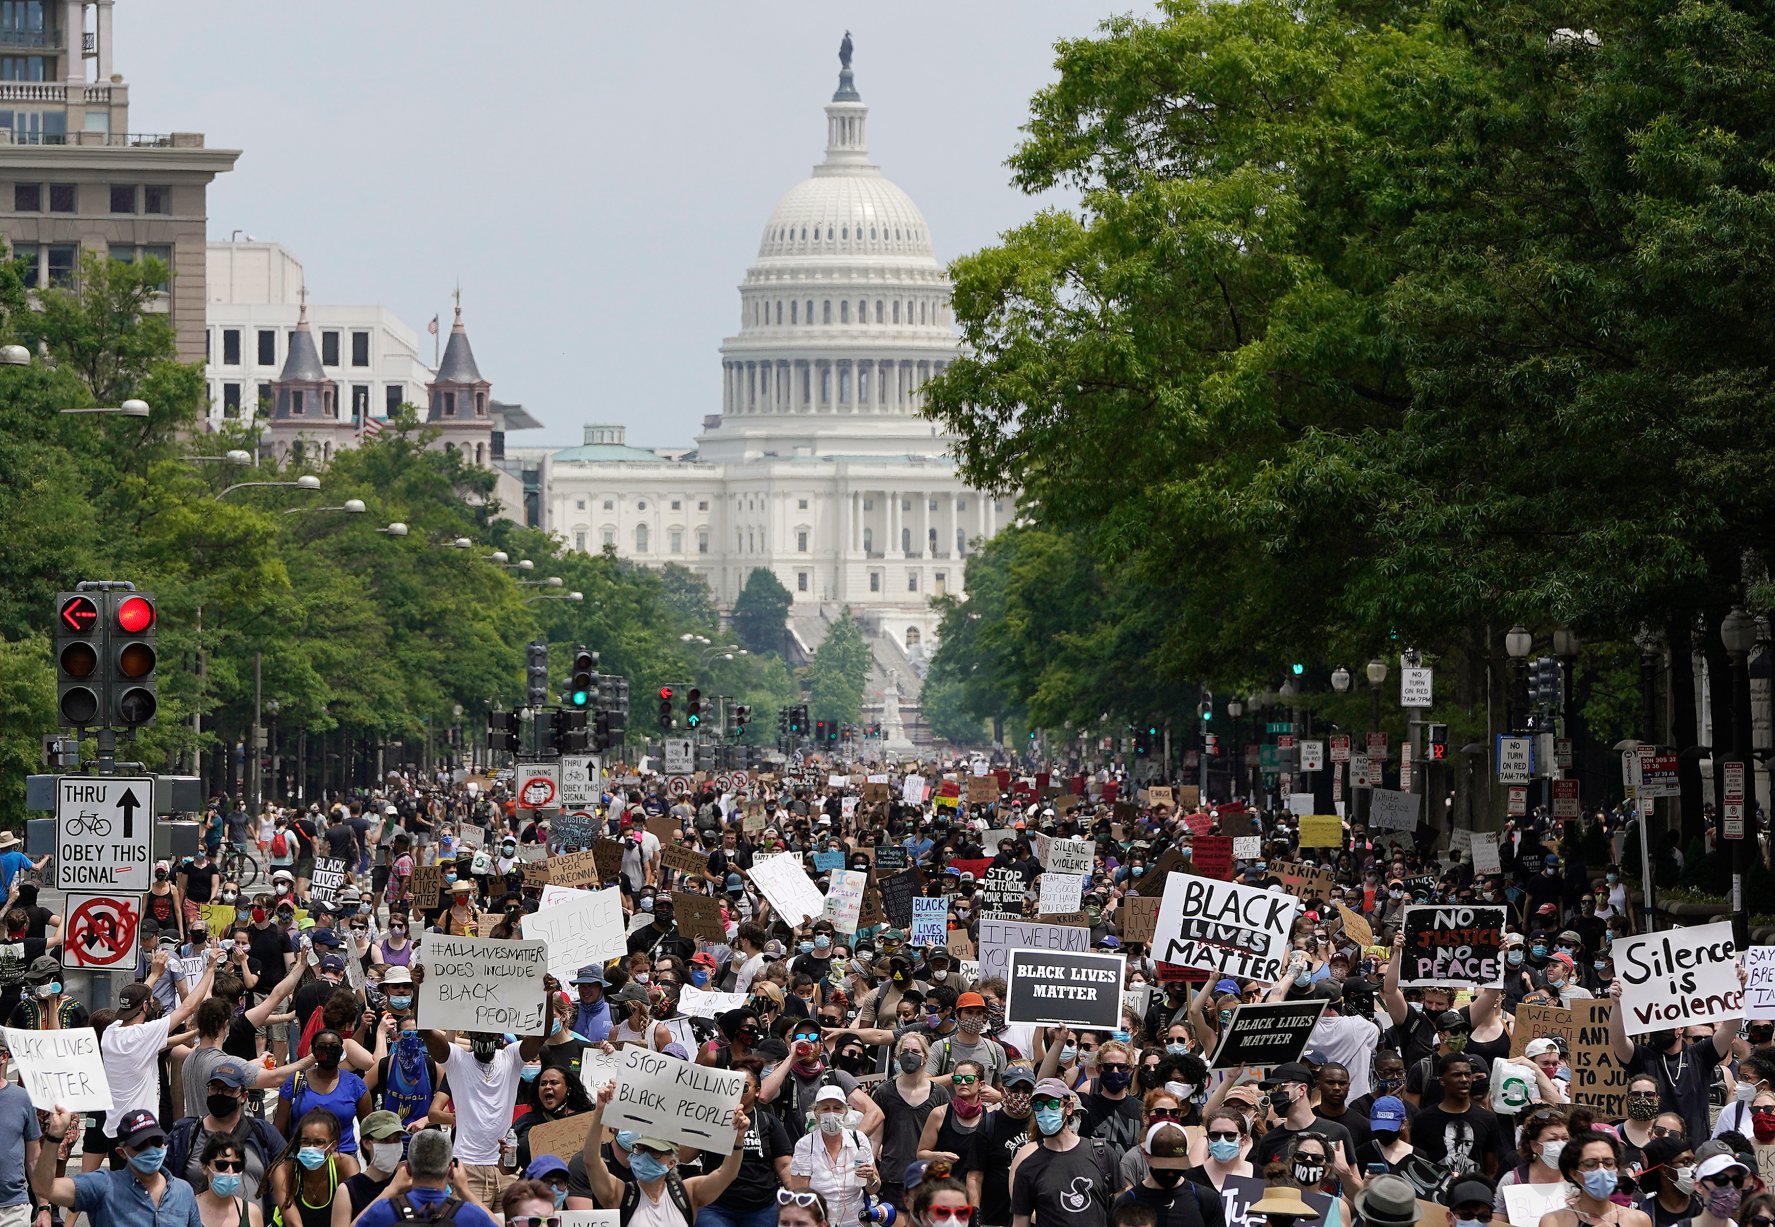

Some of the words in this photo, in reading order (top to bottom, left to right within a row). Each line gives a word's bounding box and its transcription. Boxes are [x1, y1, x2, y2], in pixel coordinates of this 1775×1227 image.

[564, 759, 582, 767] THRU
[1502, 762, 1512, 770] ON
[1514, 762, 1527, 770] RED
[1500, 772, 1528, 780] 7AM-7PM
[64, 785, 107, 803] THRU
[563, 784, 582, 792] OBEY
[563, 793, 587, 801] SIGNAL
[561, 815, 590, 825] JUSTICE
[1374, 813, 1411, 829] Violence
[62, 844, 105, 862] OBEY
[112, 845, 147, 862] THIS
[1054, 840, 1087, 854] SILENCE
[315, 857, 346, 871] BLACK
[550, 852, 592, 868] JUSTICE
[562, 862, 582, 873] FOR
[664, 853, 703, 873] MATTER
[1052, 858, 1089, 872] VIOLENCE
[62, 866, 118, 884] SIGNAL
[313, 872, 343, 887] LIVES
[414, 868, 438, 881] BLACK
[553, 867, 597, 885] BREONNA
[986, 867, 1023, 881] STOP
[1064, 875, 1081, 884] SEX
[1269, 862, 1285, 873] OUR
[1287, 864, 1321, 879] SKIN
[1325, 872, 1336, 881] IS
[413, 881, 438, 895] LIVES
[984, 878, 1027, 892] PRETENDING
[1042, 884, 1052, 893] IS
[1054, 885, 1078, 893] GOOD
[1286, 884, 1323, 897] RIME
[311, 886, 337, 901] MATTE
[983, 891, 1001, 902] YOUR
[1002, 892, 1025, 902] RACISM
[1041, 893, 1056, 902] BUT
[1059, 894, 1078, 903] HAVE
[915, 898, 945, 911] BLACK
[992, 902, 1003, 912] IS
[1040, 903, 1054, 912] YOU
[1055, 904, 1076, 912] EVER
[1131, 898, 1157, 915] BLA
[1182, 880, 1290, 935] BLACK
[532, 900, 617, 945] SILENCE
[1067, 914, 1085, 923] LIVES
[1129, 915, 1155, 929] LIV
[1433, 908, 1475, 930] NO
[918, 924, 942, 934] LIVES
[1189, 919, 1267, 953] LIVES
[560, 934, 588, 954] IS
[913, 934, 946, 946] MATTER
[983, 924, 1017, 945] IF
[1019, 927, 1043, 948] WE
[1049, 928, 1088, 951] BURN
[1417, 927, 1501, 948] JUSTICE
[548, 934, 624, 970] IOLENCE
[1165, 938, 1281, 982] MATTER
[1436, 945, 1472, 961] NO
[1749, 948, 1775, 965] SAY
[1417, 957, 1496, 979] PEACE
[1622, 937, 1735, 985] Silence
[434, 962, 475, 978] DOES
[484, 964, 535, 978] INCLUDE
[1017, 964, 1065, 980] BLACK
[1070, 968, 1117, 983] LIVES
[1669, 971, 1697, 995] is
[439, 983, 500, 1001] BLACK
[1033, 984, 1097, 1000] MATTER
[475, 1002, 544, 1031] PEOPLE!
[1234, 1018, 1273, 1031] BLACK
[1276, 1015, 1315, 1029] LIVES
[1527, 1008, 1550, 1022] WE
[1555, 1012, 1573, 1024] CA
[10, 1035, 44, 1061] BLACK
[53, 1037, 94, 1058] LIVES
[472, 1039, 484, 1051] TRY
[486, 1040, 497, 1053] ME
[1240, 1033, 1293, 1047] MATTER
[1577, 1051, 1591, 1067] IS
[1596, 1052, 1613, 1068] A
[626, 1051, 667, 1076] STOP
[675, 1065, 740, 1097] KILLING
[1575, 1068, 1597, 1087] TO
[31, 1070, 95, 1100] MATTER
[590, 1075, 606, 1090] hea
[619, 1083, 666, 1112] BLACK
[676, 1099, 734, 1127] PEOPLE
[1575, 1093, 1628, 1116] EVERY
[1294, 1165, 1324, 1183] VOTE
[1514, 1196, 1562, 1218] BLA
